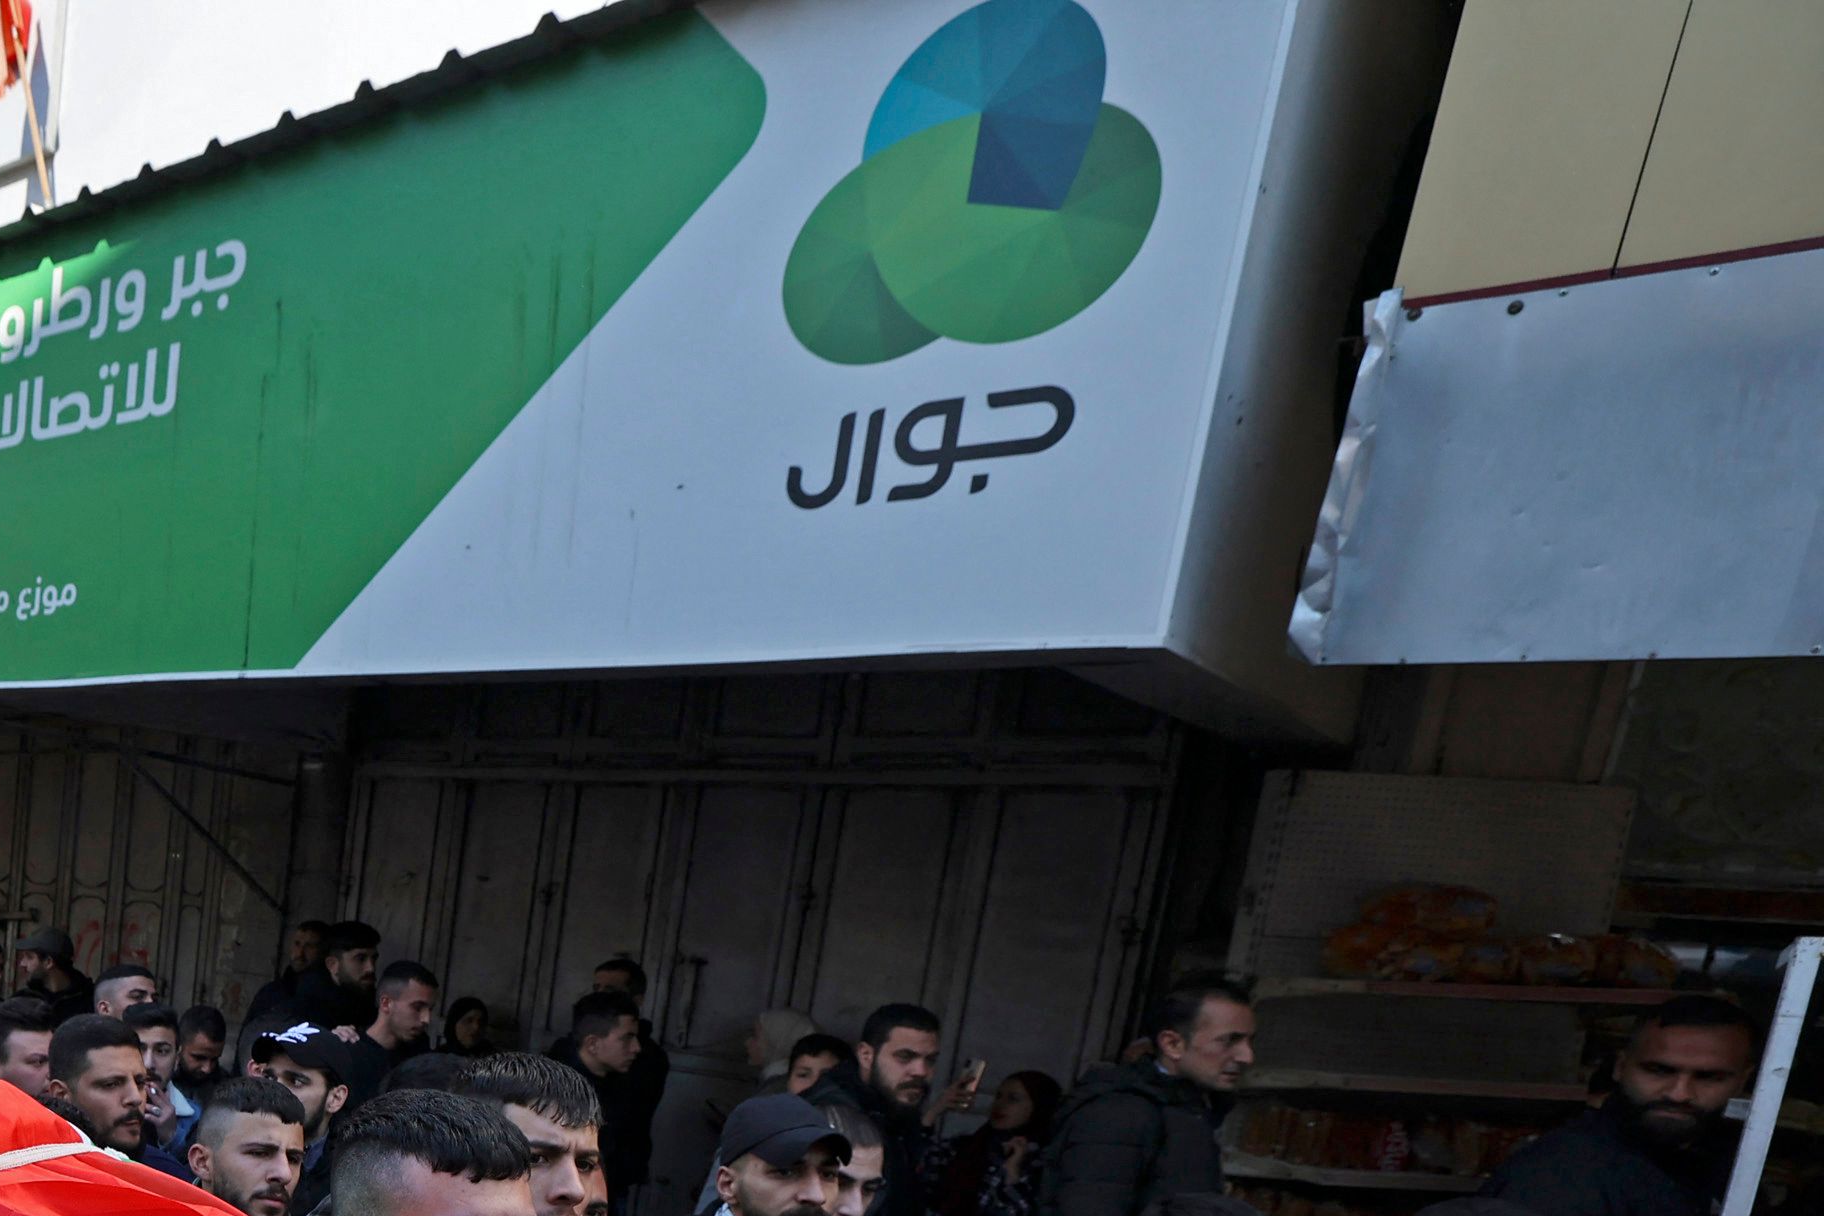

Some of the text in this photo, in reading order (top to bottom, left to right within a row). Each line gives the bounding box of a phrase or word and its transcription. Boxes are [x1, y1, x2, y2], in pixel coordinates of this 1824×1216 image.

[161, 239, 247, 318] جبر
[787, 385, 1075, 510] جوال
[16, 578, 77, 620] موزع
